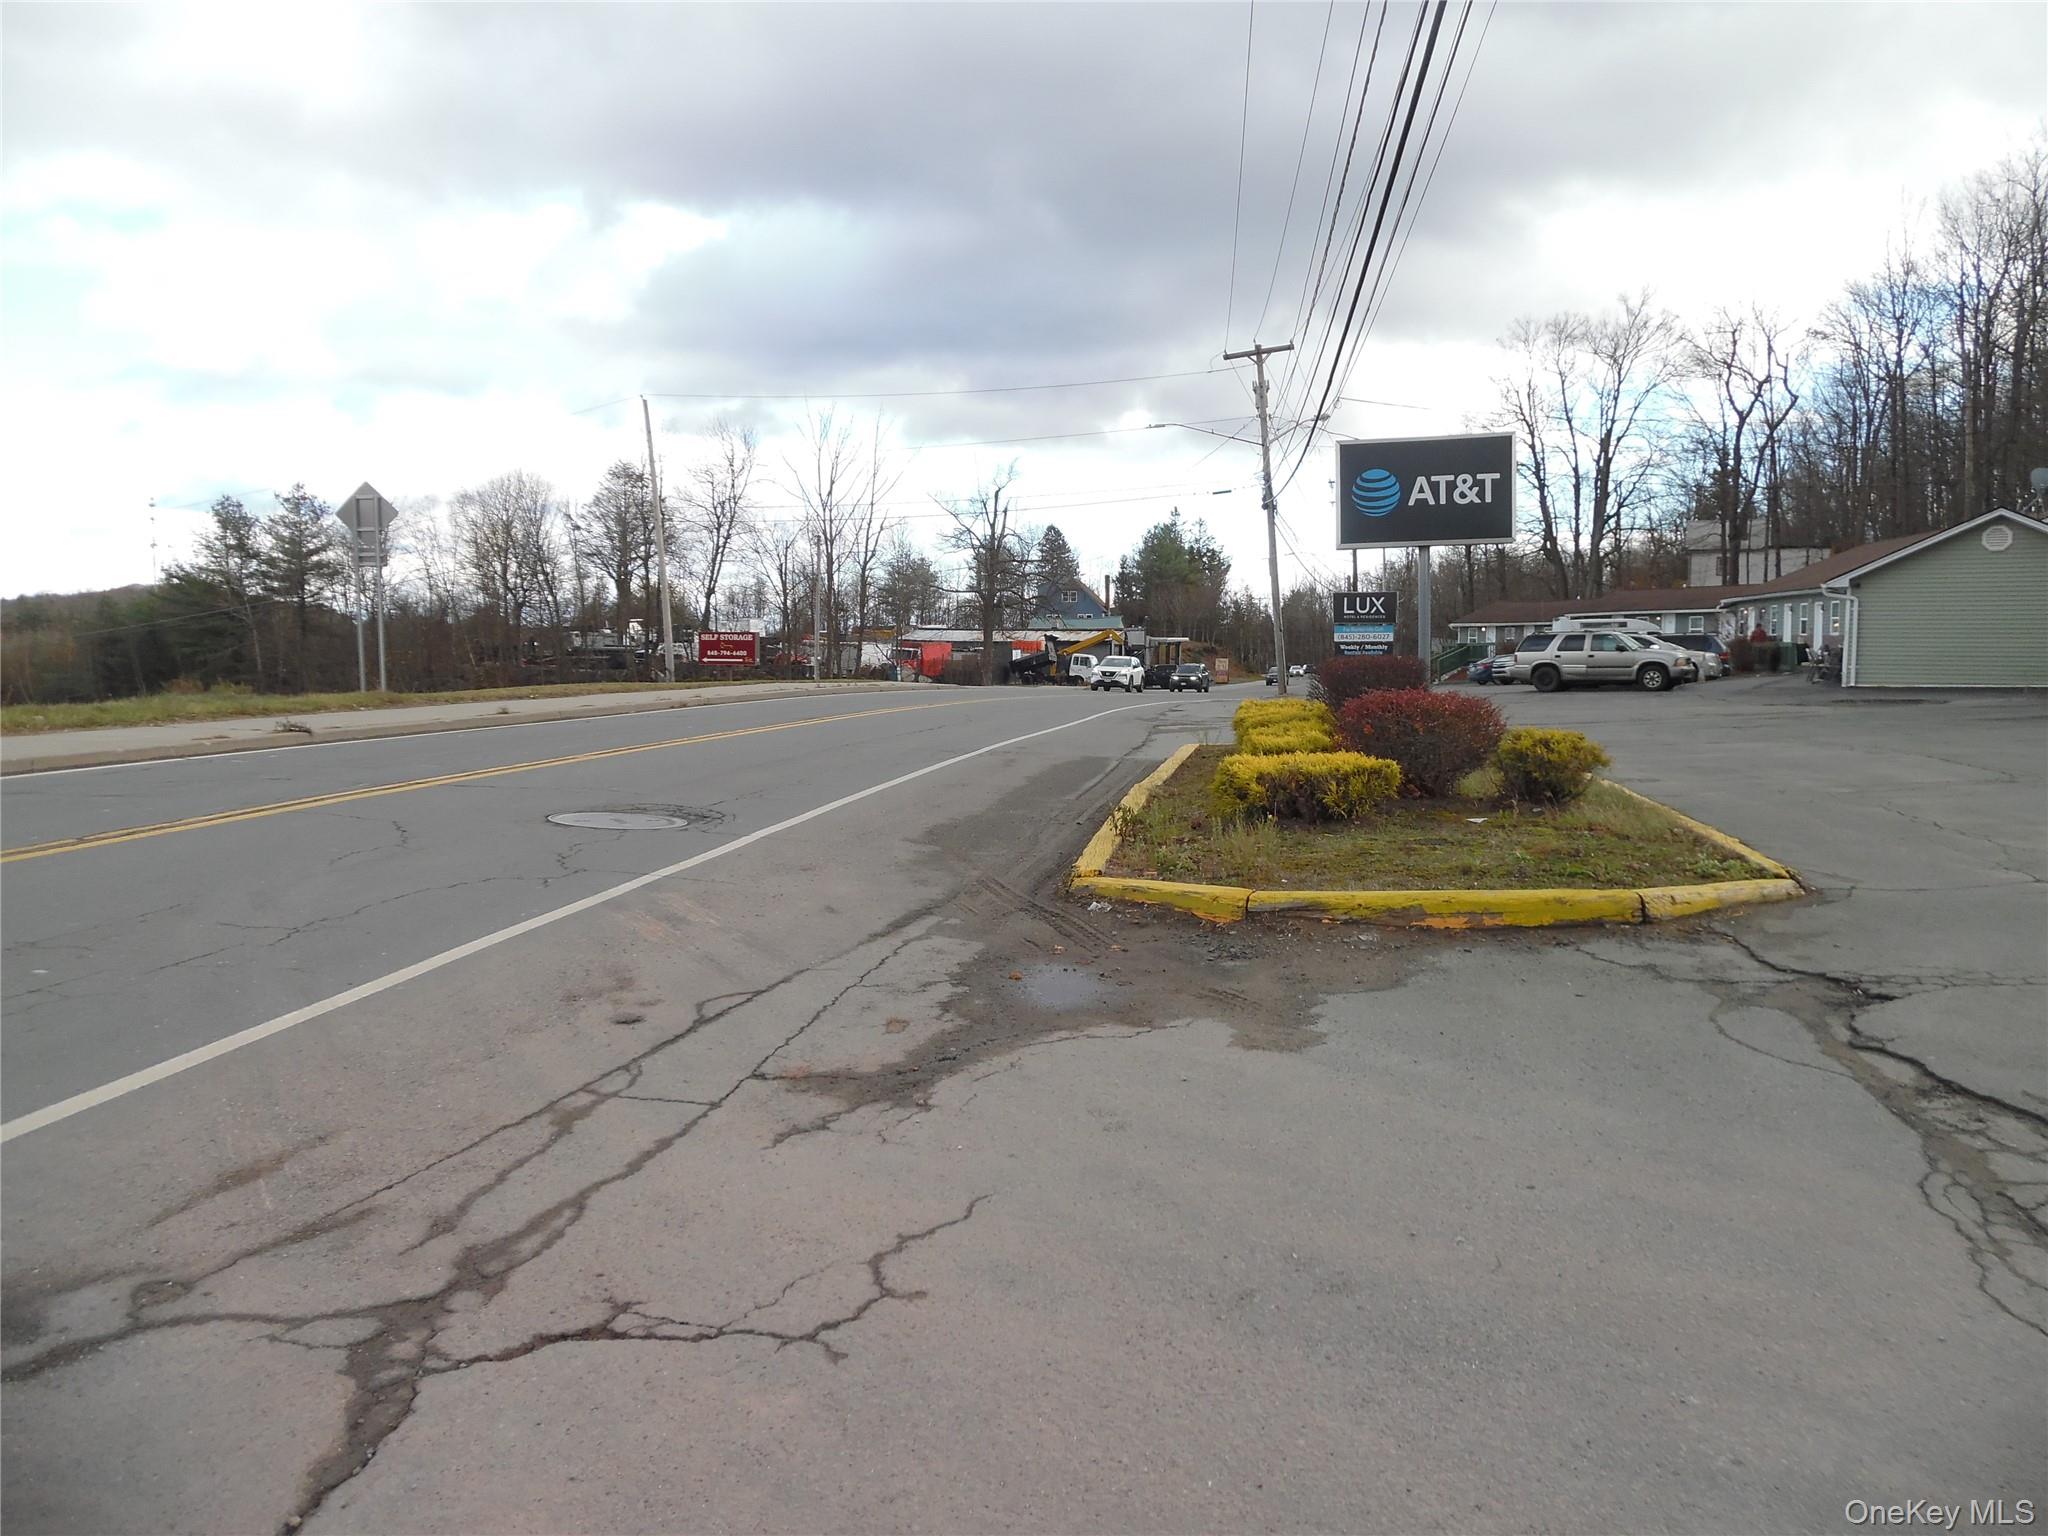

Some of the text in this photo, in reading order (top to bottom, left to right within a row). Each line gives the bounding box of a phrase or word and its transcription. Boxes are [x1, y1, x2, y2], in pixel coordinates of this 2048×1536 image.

[1408, 473, 1500, 506] AT&T
[1343, 596, 1386, 614] LUX
[700, 633, 753, 641] SELF STORAGE
